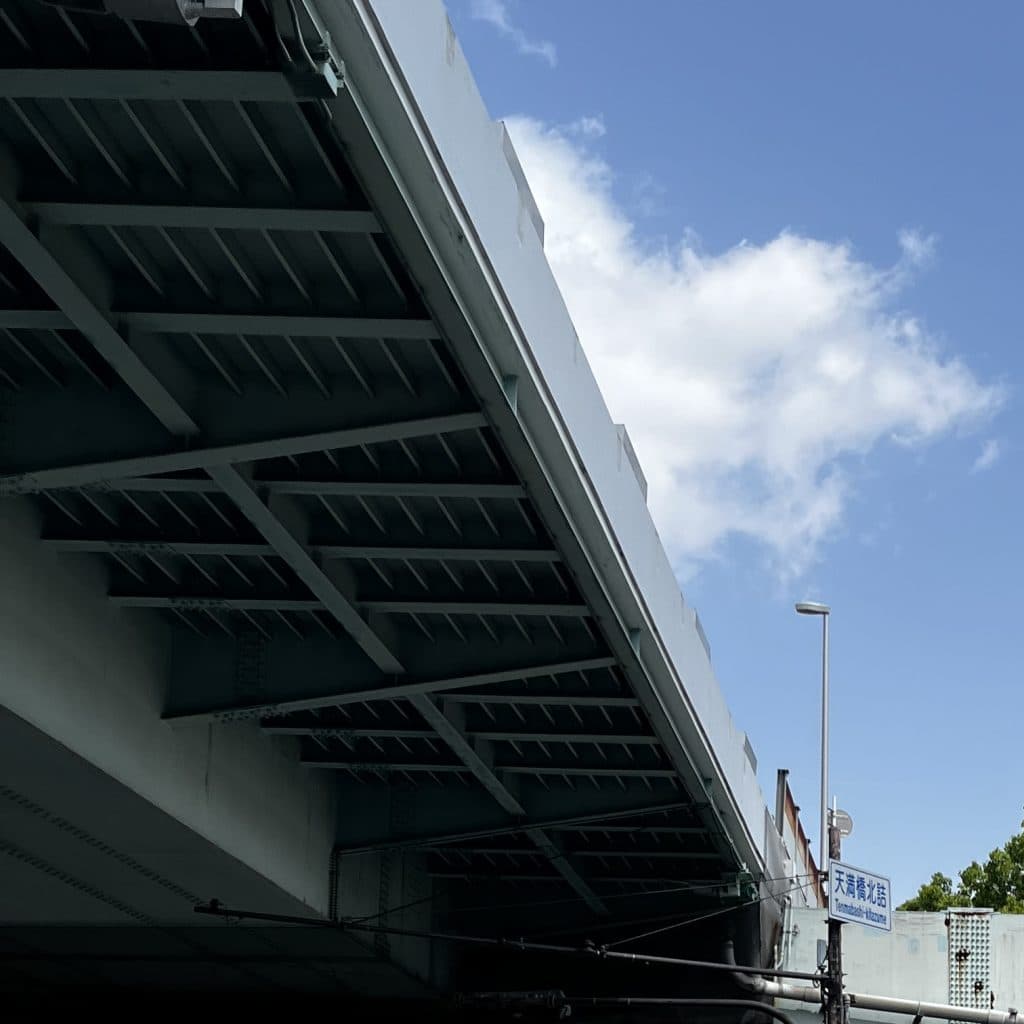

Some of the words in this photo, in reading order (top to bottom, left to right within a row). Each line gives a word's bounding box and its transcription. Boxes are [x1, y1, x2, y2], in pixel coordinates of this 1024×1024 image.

[835, 869, 887, 908] 天満橋北詰
